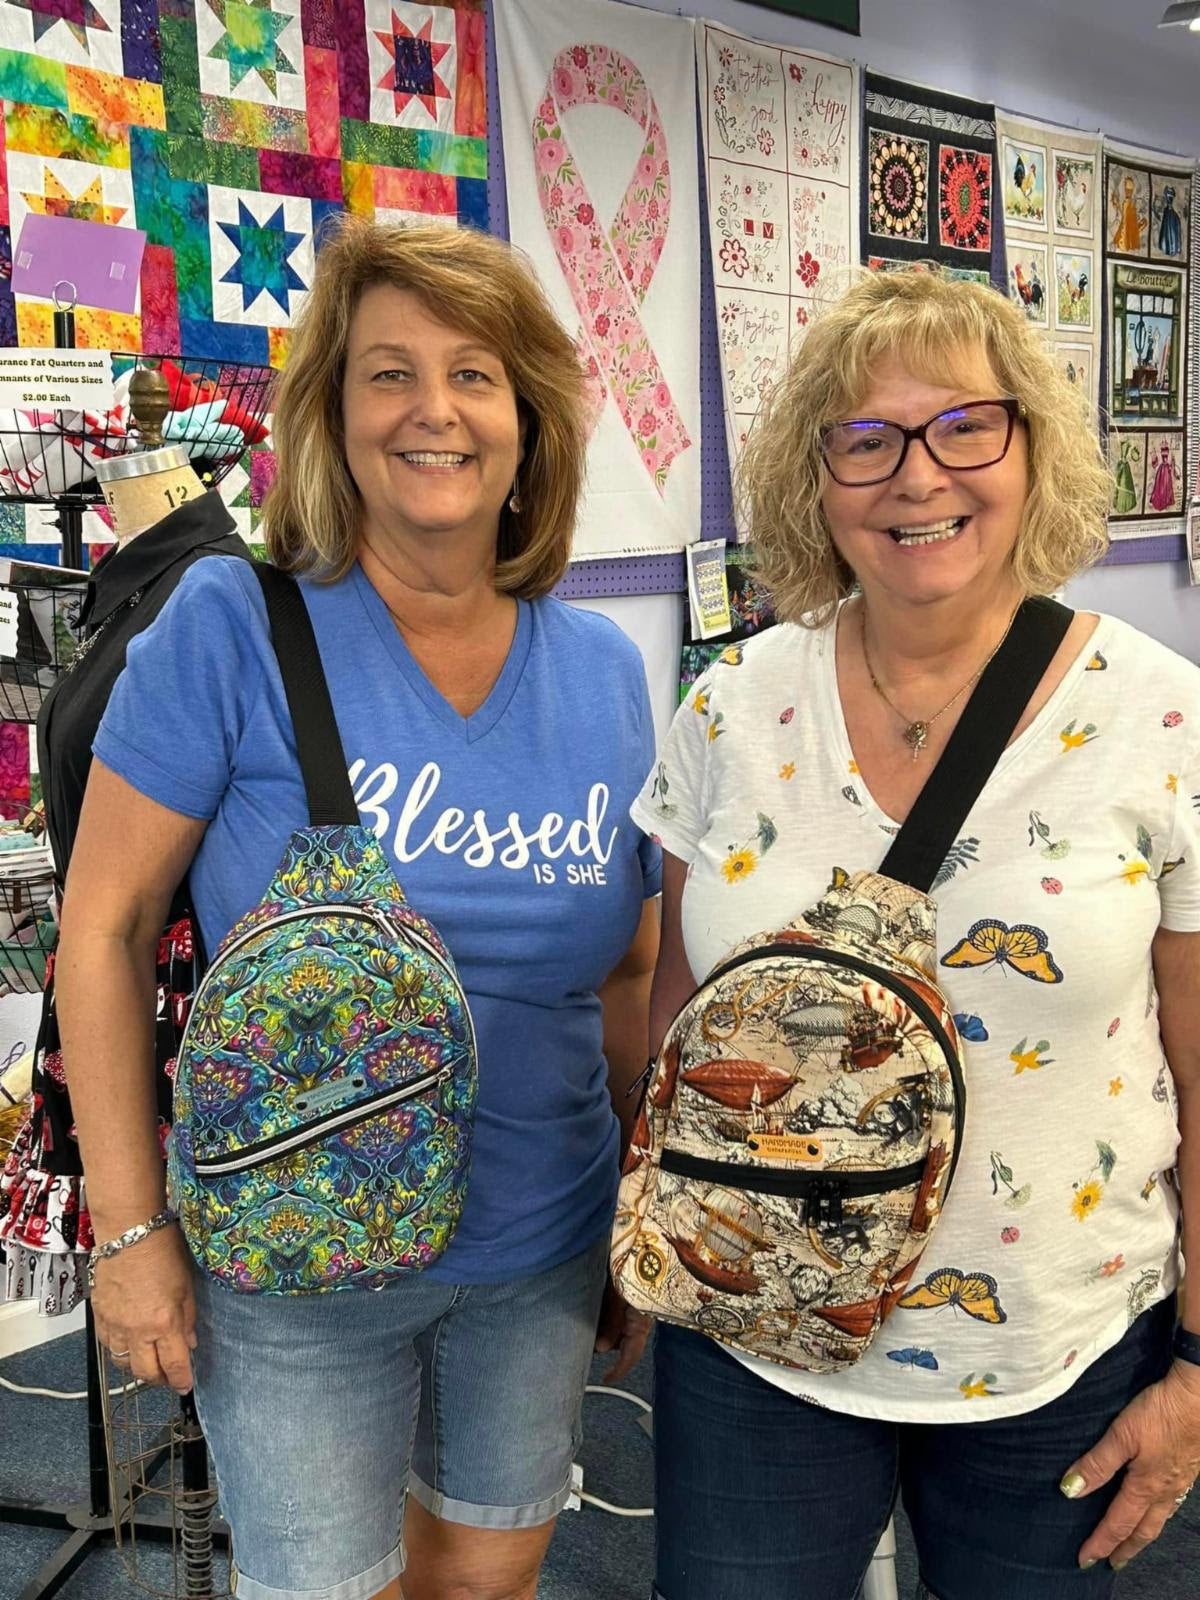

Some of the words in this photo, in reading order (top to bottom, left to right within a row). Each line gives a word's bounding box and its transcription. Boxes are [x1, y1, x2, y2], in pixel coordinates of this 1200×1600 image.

[811, 73, 847, 148] happy
[31, 358, 46, 366] Fat
[48, 358, 86, 368] Quarters
[88, 360, 104, 368] and
[45, 375, 79, 383] Various
[81, 376, 103, 384] Sizes
[22, 393, 47, 402] $2.00
[49, 394, 71, 402] Each
[164, 486, 188, 508] 12
[348, 758, 618, 869] Blessed
[533, 863, 556, 884] IS
[567, 864, 607, 885] SHE
[761, 1138, 806, 1149] HANDMADE
